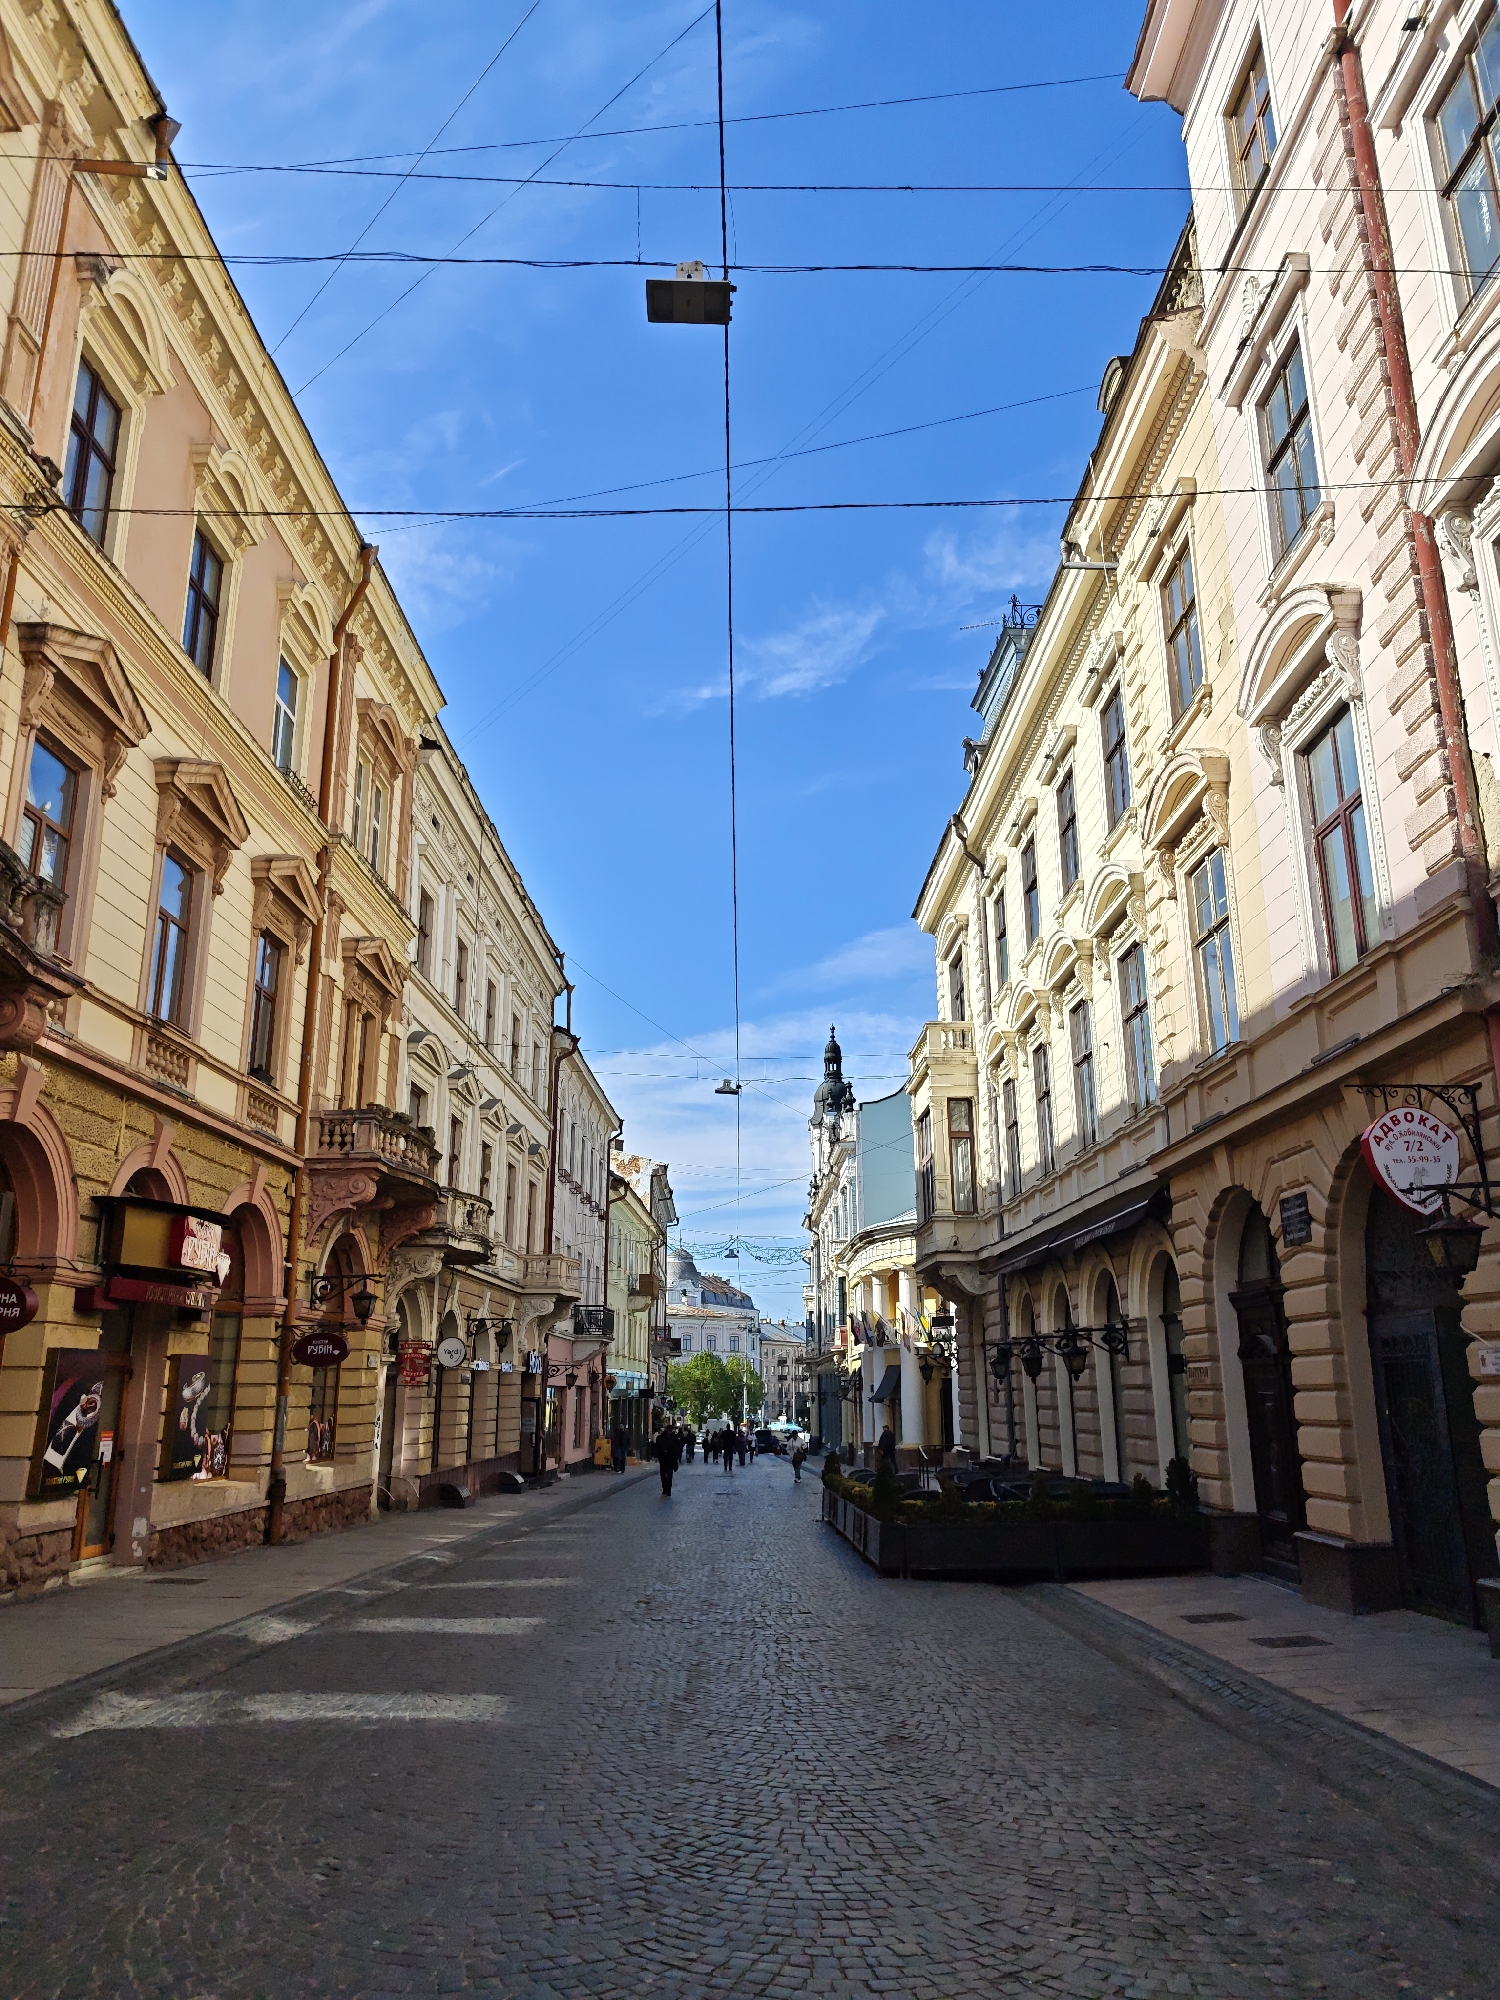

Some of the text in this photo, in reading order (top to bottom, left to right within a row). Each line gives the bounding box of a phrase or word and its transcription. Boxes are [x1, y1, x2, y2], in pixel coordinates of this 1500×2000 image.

[1373, 1111, 1453, 1147] АДВОКАТ
[1403, 1139, 1424, 1153] 7/2
[307, 1344, 333, 1355] РУБІН
